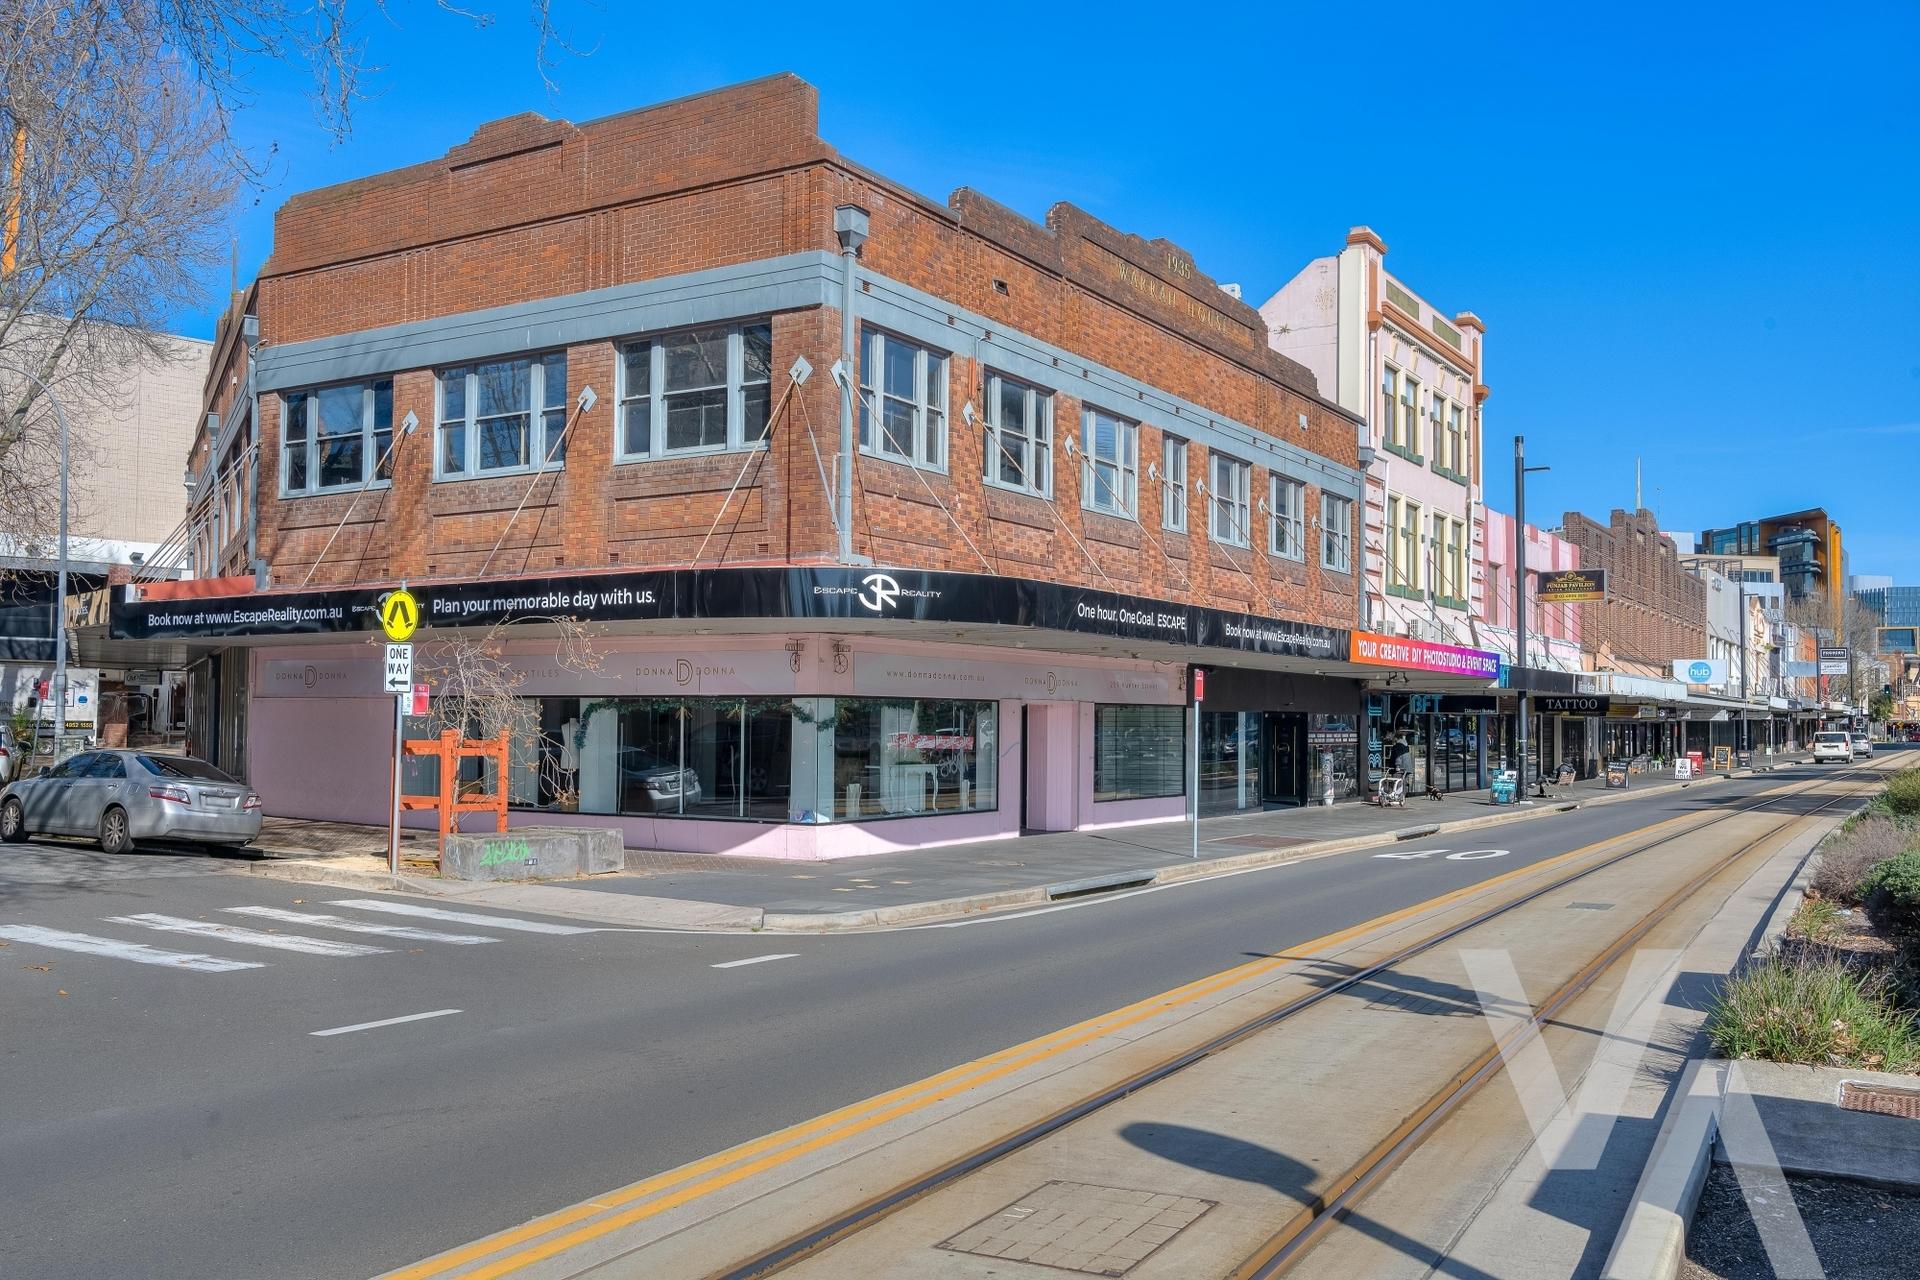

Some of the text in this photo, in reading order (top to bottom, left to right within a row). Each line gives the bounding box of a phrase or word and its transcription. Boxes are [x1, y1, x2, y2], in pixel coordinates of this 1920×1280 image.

[1167, 253, 1191, 280] 1935
[814, 586, 858, 594] ESCAPE
[901, 588, 942, 598] REALITY
[433, 598, 460, 614] Plan
[462, 599, 490, 616] your
[492, 591, 570, 611] memorable
[573, 590, 598, 610] day
[600, 588, 632, 606] with
[636, 589, 656, 604] us.
[148, 606, 343, 627] Book now at www.EscapeReality.com.au
[1077, 602, 1096, 618] One
[1097, 604, 1118, 621] hour.
[1119, 608, 1136, 624] One
[1136, 611, 1156, 627] Goal.
[1225, 623, 1241, 637] Book
[389, 647, 409, 660] ONE
[1357, 639, 1497, 673] YOUR CREATIVE DIY PHOTOSTUDIO & EVENT SPACE
[388, 663, 409, 675] WAY
[635, 667, 674, 677] DONNA
[695, 666, 736, 676] DONNA
[1690, 667, 1710, 677] hub
[1546, 698, 1598, 710] TATTOO
